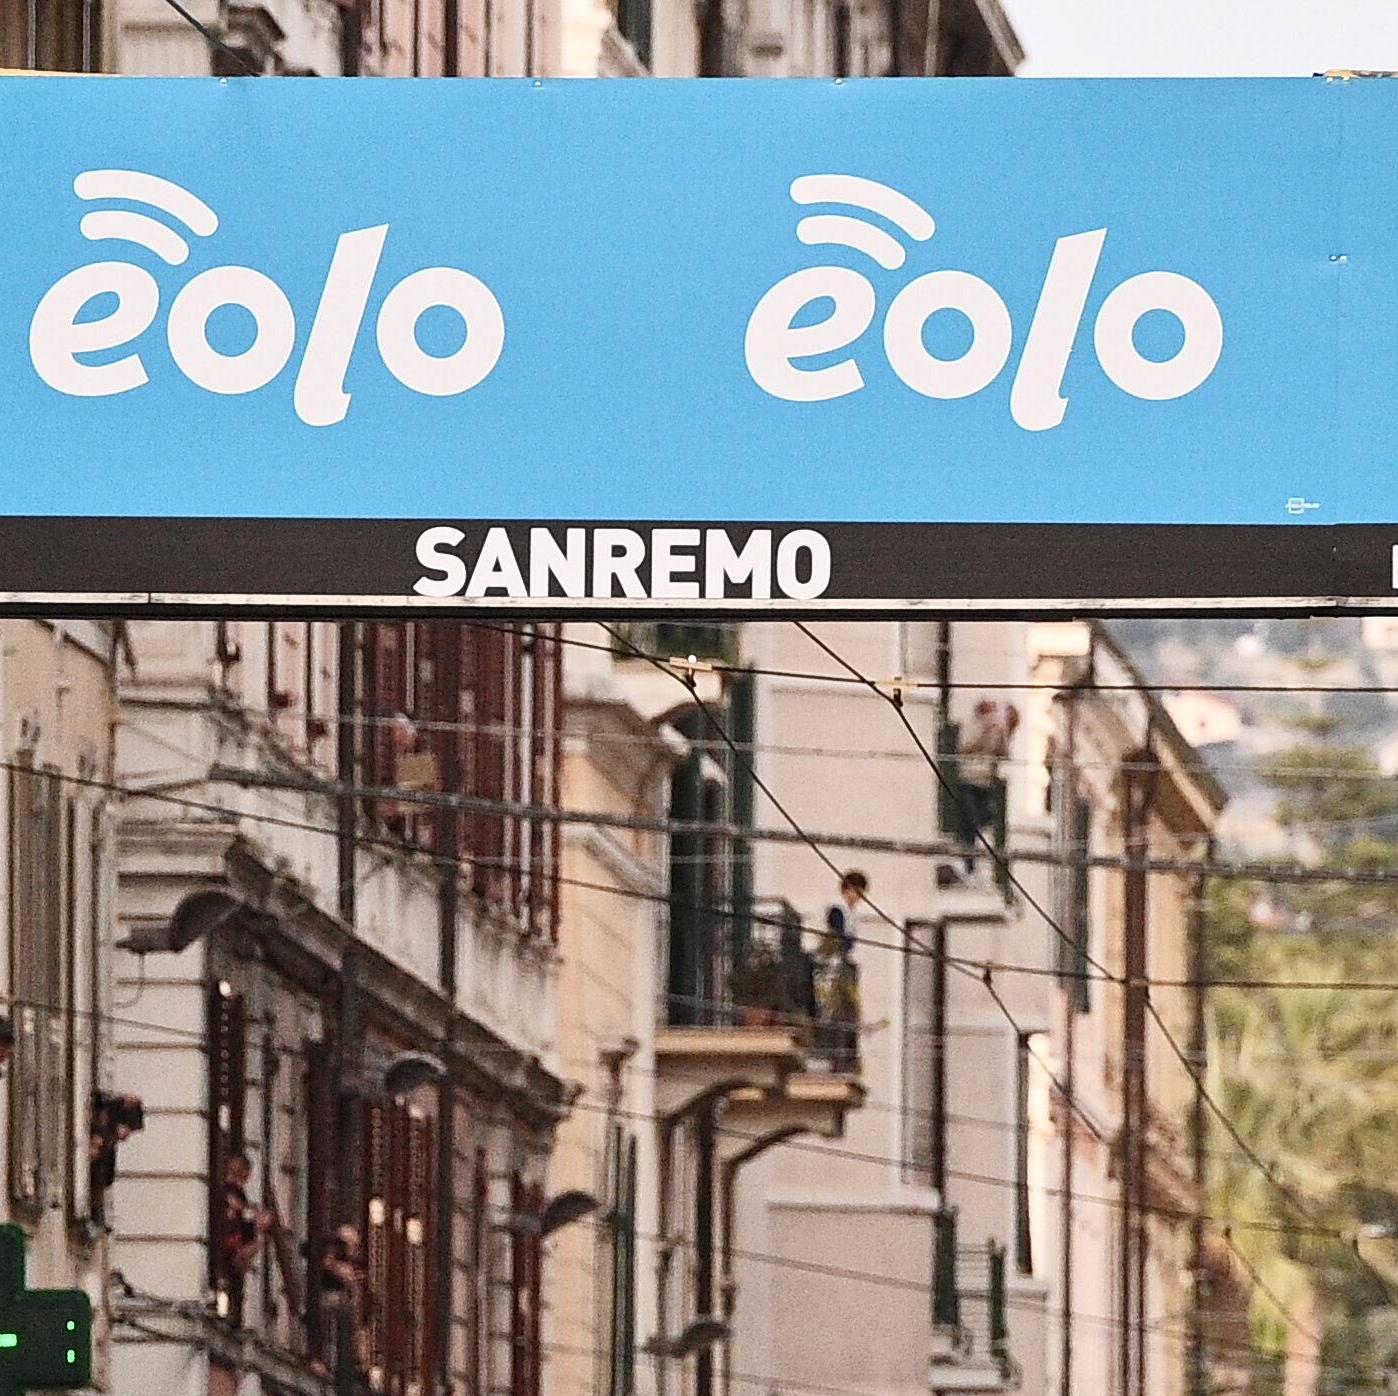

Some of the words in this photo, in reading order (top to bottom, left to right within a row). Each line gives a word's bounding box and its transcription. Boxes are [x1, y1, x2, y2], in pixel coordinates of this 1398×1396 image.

[30, 224, 505, 426] eolo
[745, 228, 1223, 431] eolo
[412, 528, 832, 597] SANREMO
